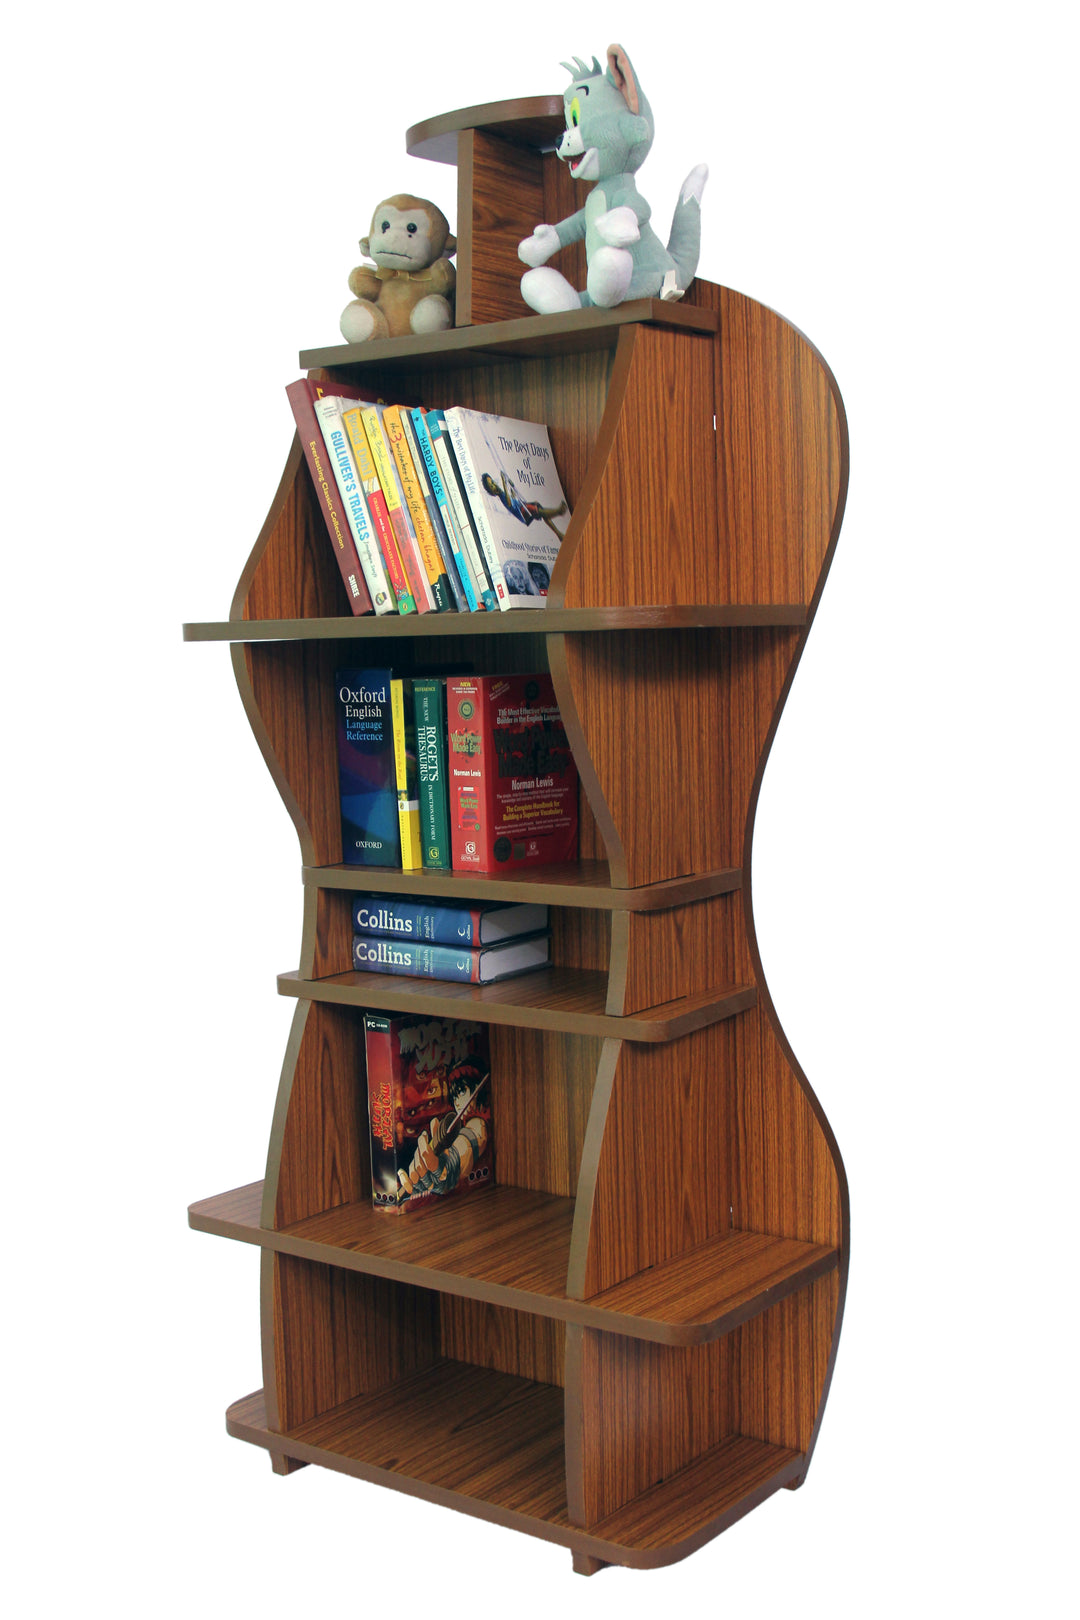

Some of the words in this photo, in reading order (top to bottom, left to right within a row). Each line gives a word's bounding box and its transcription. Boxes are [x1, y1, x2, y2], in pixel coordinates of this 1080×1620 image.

[390, 422, 400, 434] the
[346, 412, 364, 445] Roald
[356, 447, 373, 476] Dahl
[390, 432, 402, 443] 3
[420, 437, 435, 468] HARDY
[498, 436, 513, 453] The
[513, 439, 530, 456] Best
[530, 442, 550, 461] Days
[396, 443, 408, 475] mistakes
[523, 457, 532, 470] of
[330, 430, 357, 492] GULLIVER'S
[348, 492, 370, 541] TRAVELS
[403, 475, 414, 483] of
[517, 469, 531, 488] My
[529, 472, 545, 487] Life
[309, 440, 325, 482] Everlasting
[321, 481, 333, 511] Classics
[330, 511, 345, 550] Collection
[406, 486, 414, 499] my
[410, 500, 421, 513] life
[416, 517, 425, 542] chetan
[423, 544, 435, 572] bhagat
[340, 686, 387, 703] Oxford
[345, 705, 382, 720] English
[346, 719, 383, 731] Language
[346, 730, 383, 741] Reference
[450, 730, 466, 743] Word
[417, 725, 429, 782] THESAURUS
[426, 726, 439, 781] ROGET'S
[453, 769, 470, 777] Norman
[470, 769, 482, 777] Lewis
[511, 779, 536, 791] Norman
[535, 776, 554, 788] Lewis
[355, 840, 383, 849] OXFORD
[357, 909, 413, 933] Collins
[356, 943, 412, 966] Collins
